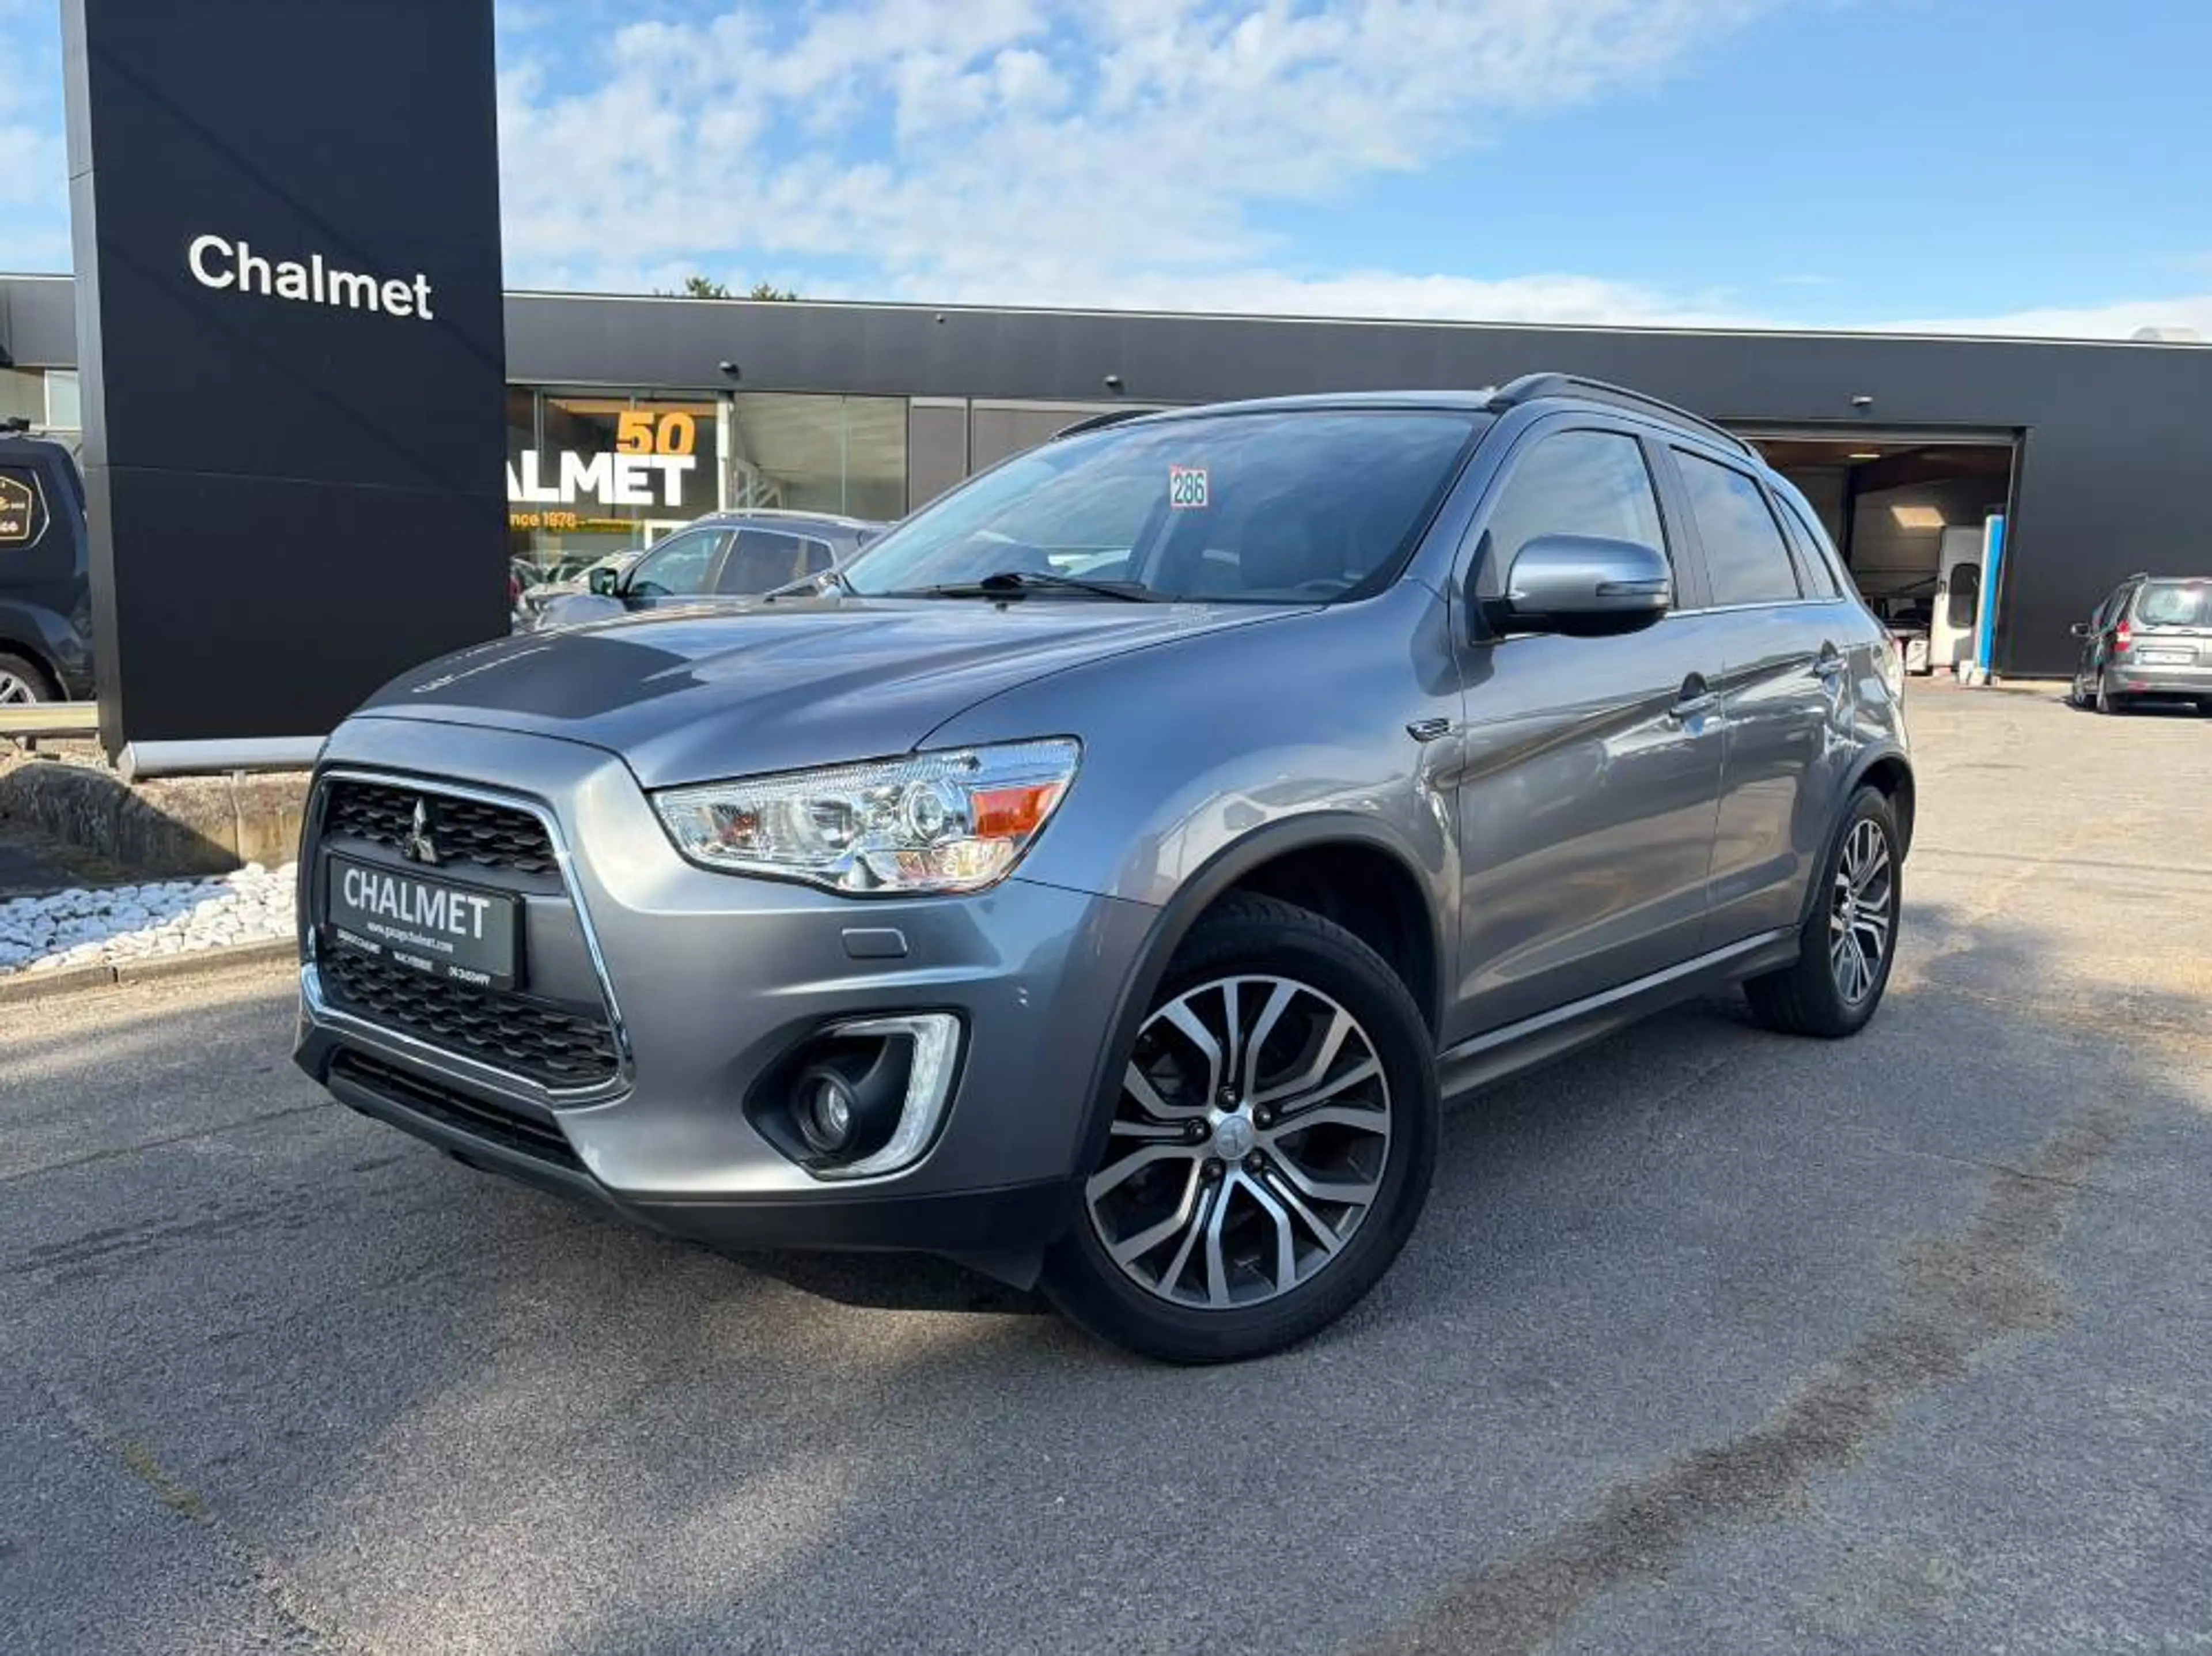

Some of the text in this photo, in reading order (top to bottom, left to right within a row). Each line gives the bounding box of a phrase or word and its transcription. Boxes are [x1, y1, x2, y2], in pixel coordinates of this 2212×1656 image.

[188, 234, 434, 320] Chalmet
[616, 411, 695, 455] 50
[1173, 472, 1205, 504] 286
[344, 868, 491, 940] CHALMET
